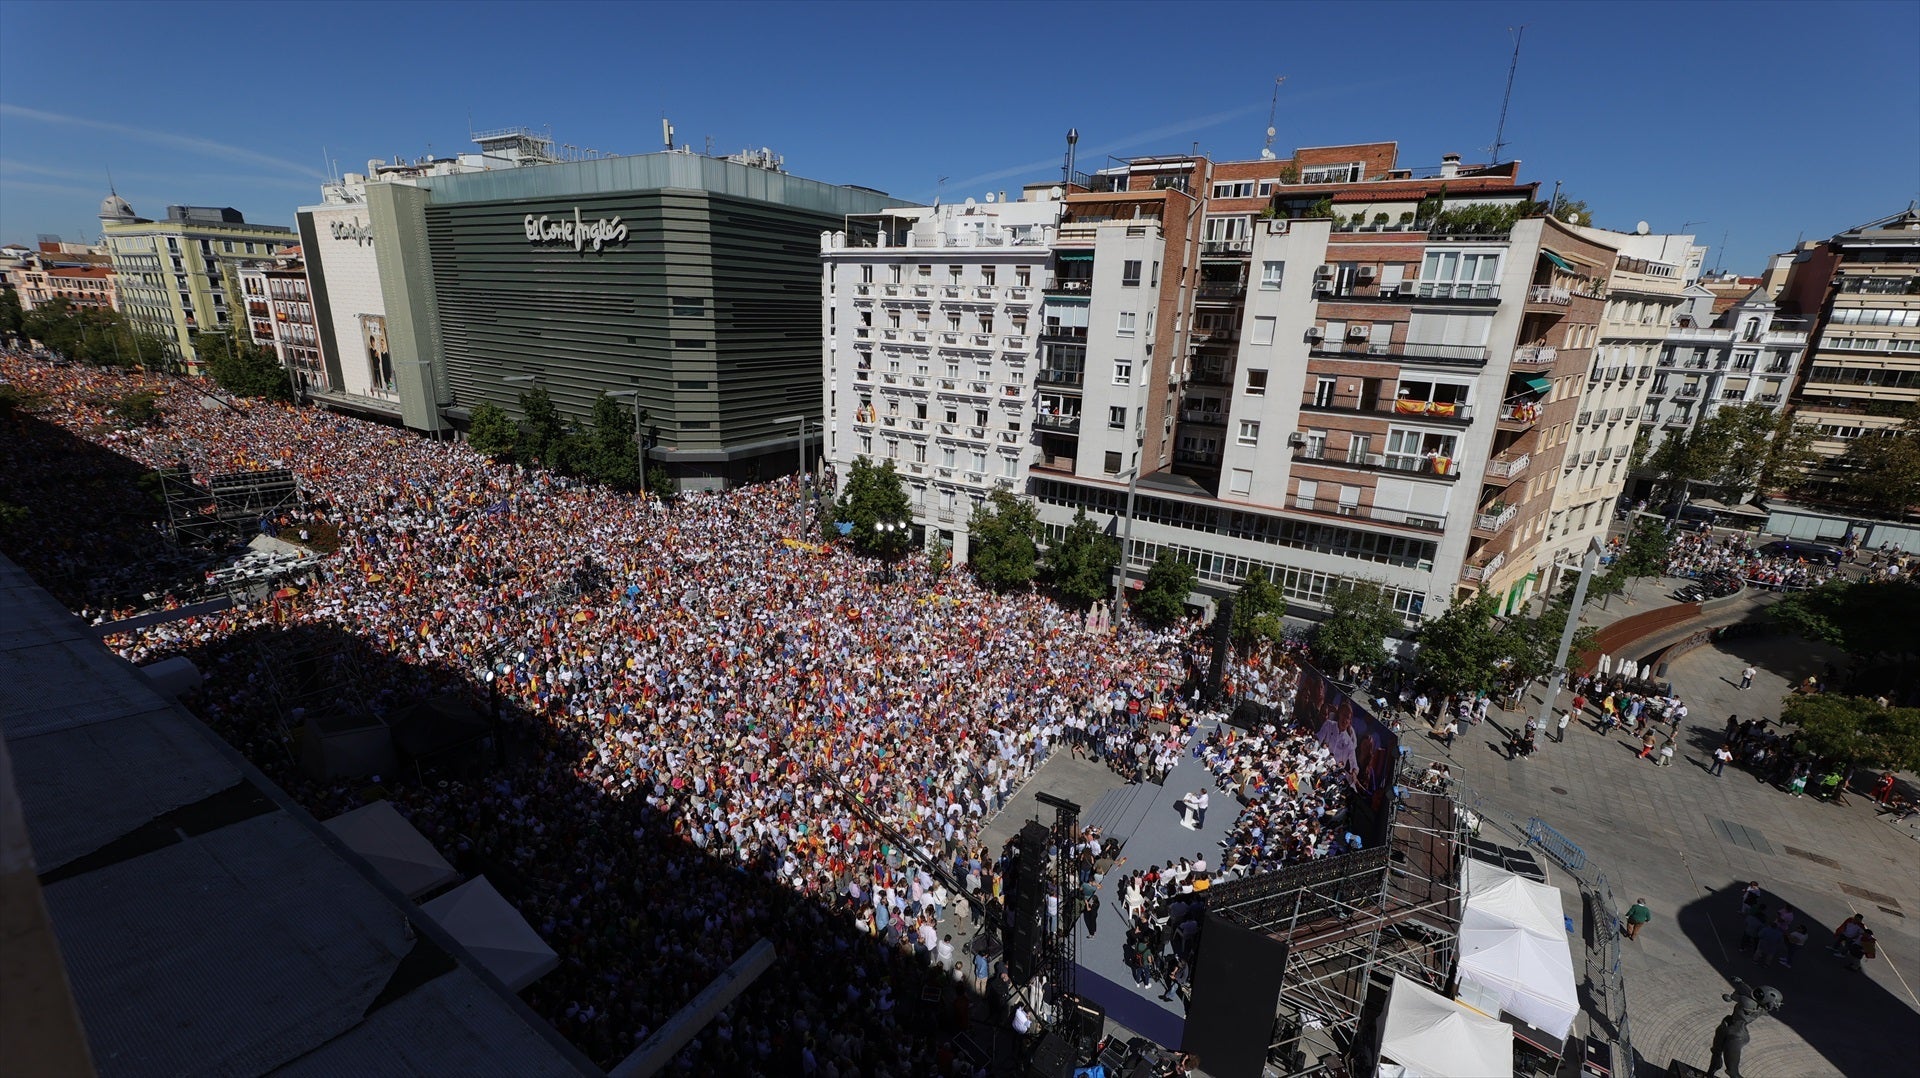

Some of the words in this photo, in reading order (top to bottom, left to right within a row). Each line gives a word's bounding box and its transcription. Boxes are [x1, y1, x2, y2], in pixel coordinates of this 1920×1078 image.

[524, 214, 540, 241] El
[539, 215, 574, 242] Corte
[574, 206, 628, 252] Inglés
